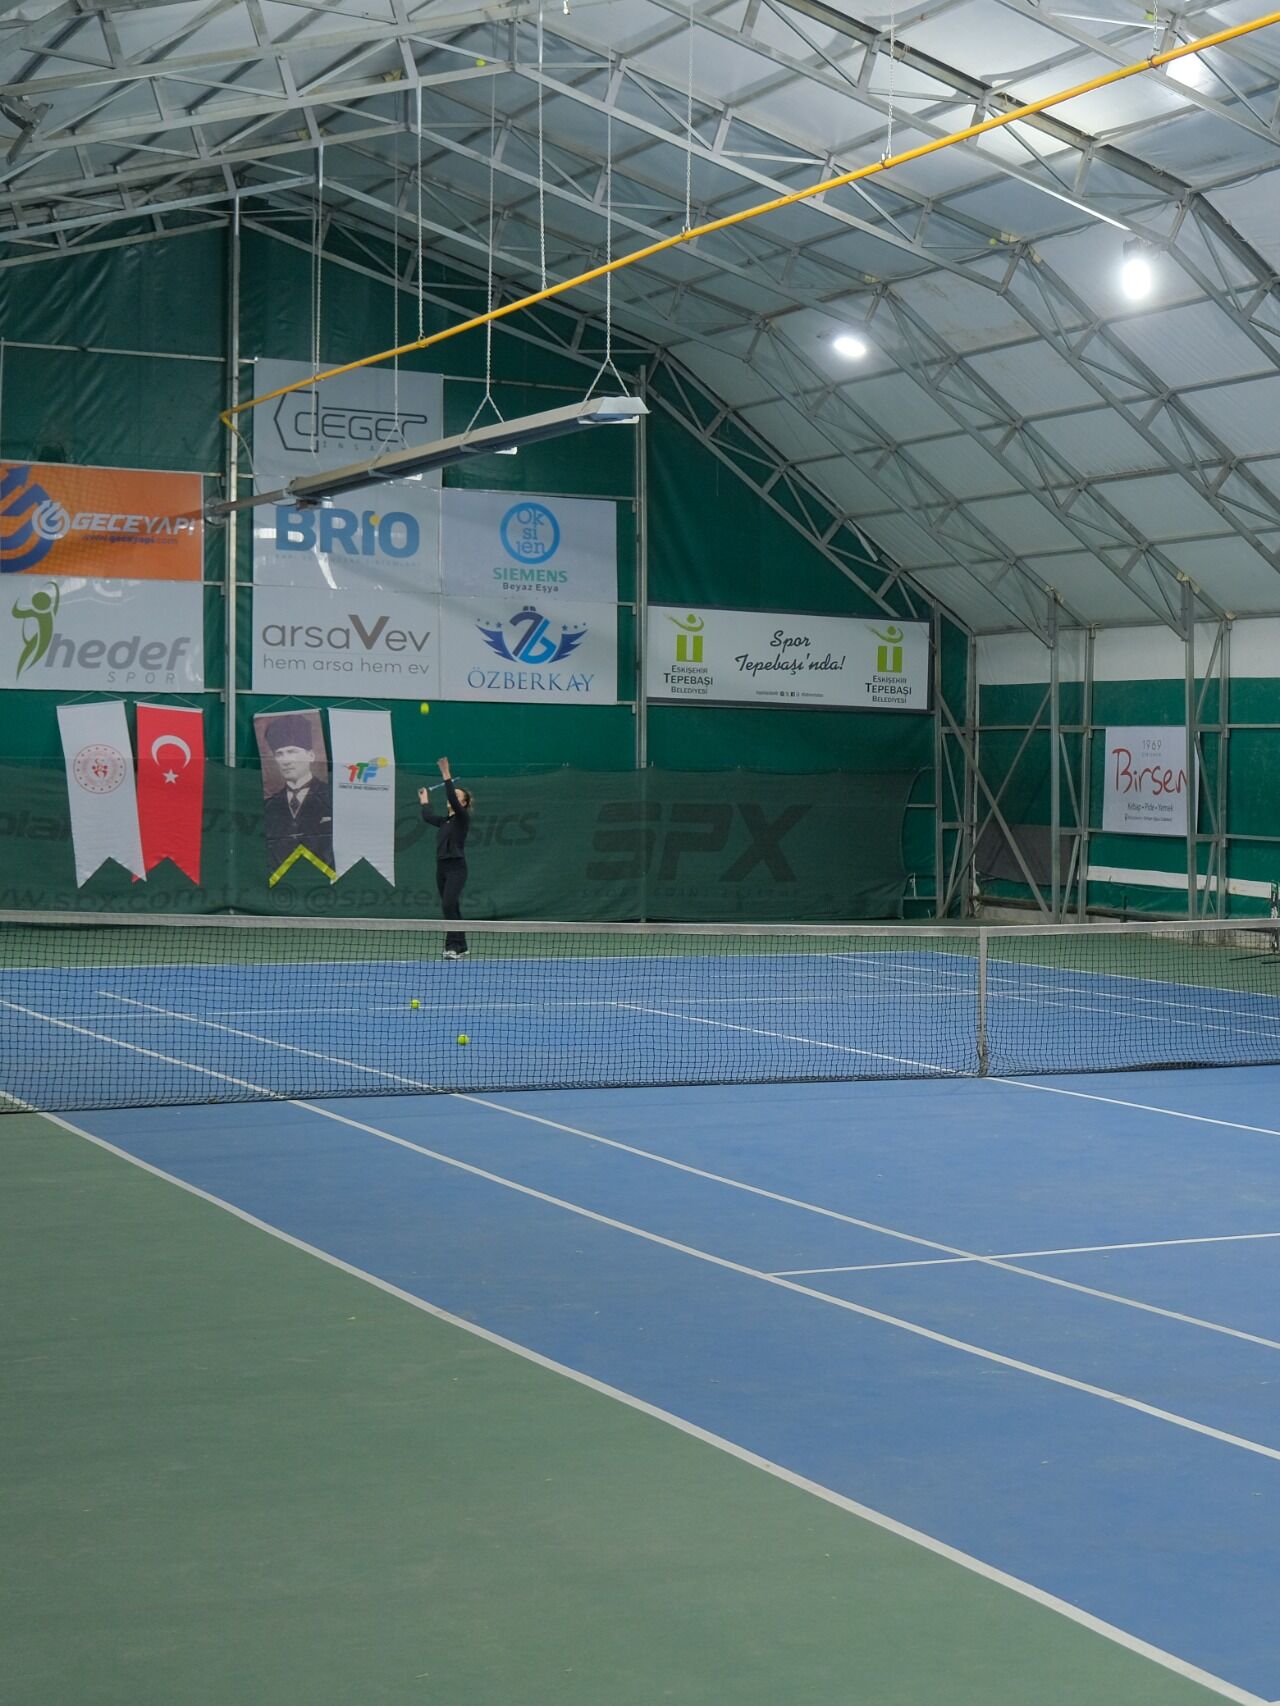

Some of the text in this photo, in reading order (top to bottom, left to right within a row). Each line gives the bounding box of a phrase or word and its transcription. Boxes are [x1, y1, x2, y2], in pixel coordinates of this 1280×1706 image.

[492, 567, 568, 583] SIEMENS
[502, 582, 559, 593] Beyaz Eşya
[44, 633, 191, 671] hedef
[769, 630, 812, 654] Spor
[263, 653, 430, 674] hem arsa hem ev
[734, 653, 846, 677] Tepebaşı'nda!
[107, 671, 176, 684] SPOR
[467, 666, 595, 692] ÖZBERKAY
[1142, 739, 1162, 750] 1969
[585, 803, 813, 882] SPX
